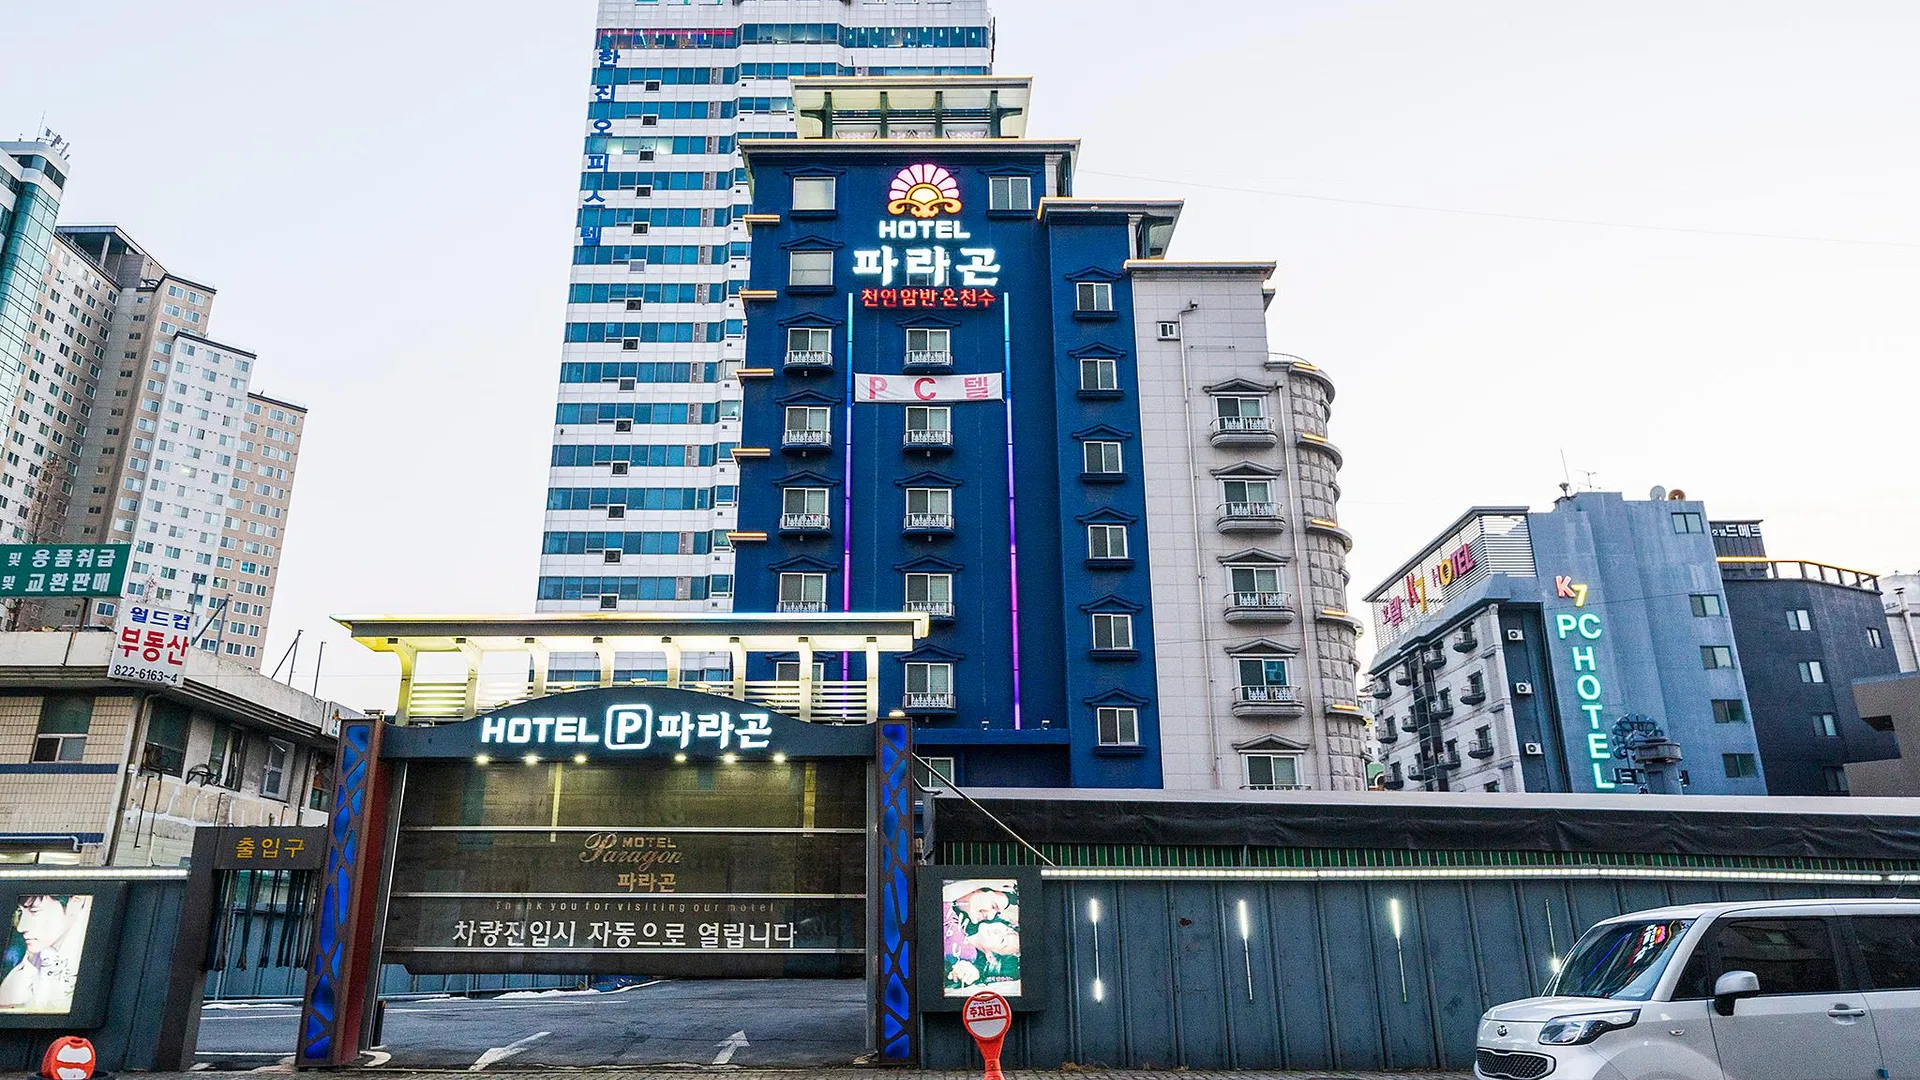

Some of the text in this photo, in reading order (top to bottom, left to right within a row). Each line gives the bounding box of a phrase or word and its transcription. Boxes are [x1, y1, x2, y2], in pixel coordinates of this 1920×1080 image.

[878, 220, 971, 239] HOTEL
[852, 245, 1001, 287] 파라곤
[861, 288, 996, 308] 천연암반온천수
[8, 549, 116, 567] 및 용품취급
[1, 572, 111, 592] 및 교환판매
[1404, 572, 1427, 613] K7
[1431, 543, 1476, 588] HOTEL
[1555, 575, 1588, 608] K7
[130, 606, 191, 631] 월드컵
[1556, 613, 1602, 640] PC
[117, 626, 190, 666] 부동산
[113, 664, 178, 684] 822-6163~4
[1571, 645, 1616, 790] HOTEL
[480, 717, 600, 744] HOTEL
[656, 711, 773, 750] 파라곤
[235, 836, 305, 860] 출입구
[579, 832, 683, 872] Paragon
[622, 836, 677, 849] MOTEL
[617, 871, 677, 893] 파라곤
[550, 901, 578, 912] you
[585, 900, 609, 911] for
[617, 900, 686, 914] visiting
[693, 903, 720, 912] our
[727, 901, 775, 912] motel
[452, 920, 798, 948] 차량진입시 자동으로 열립니다
[969, 1003, 1002, 1018] 주차금지
